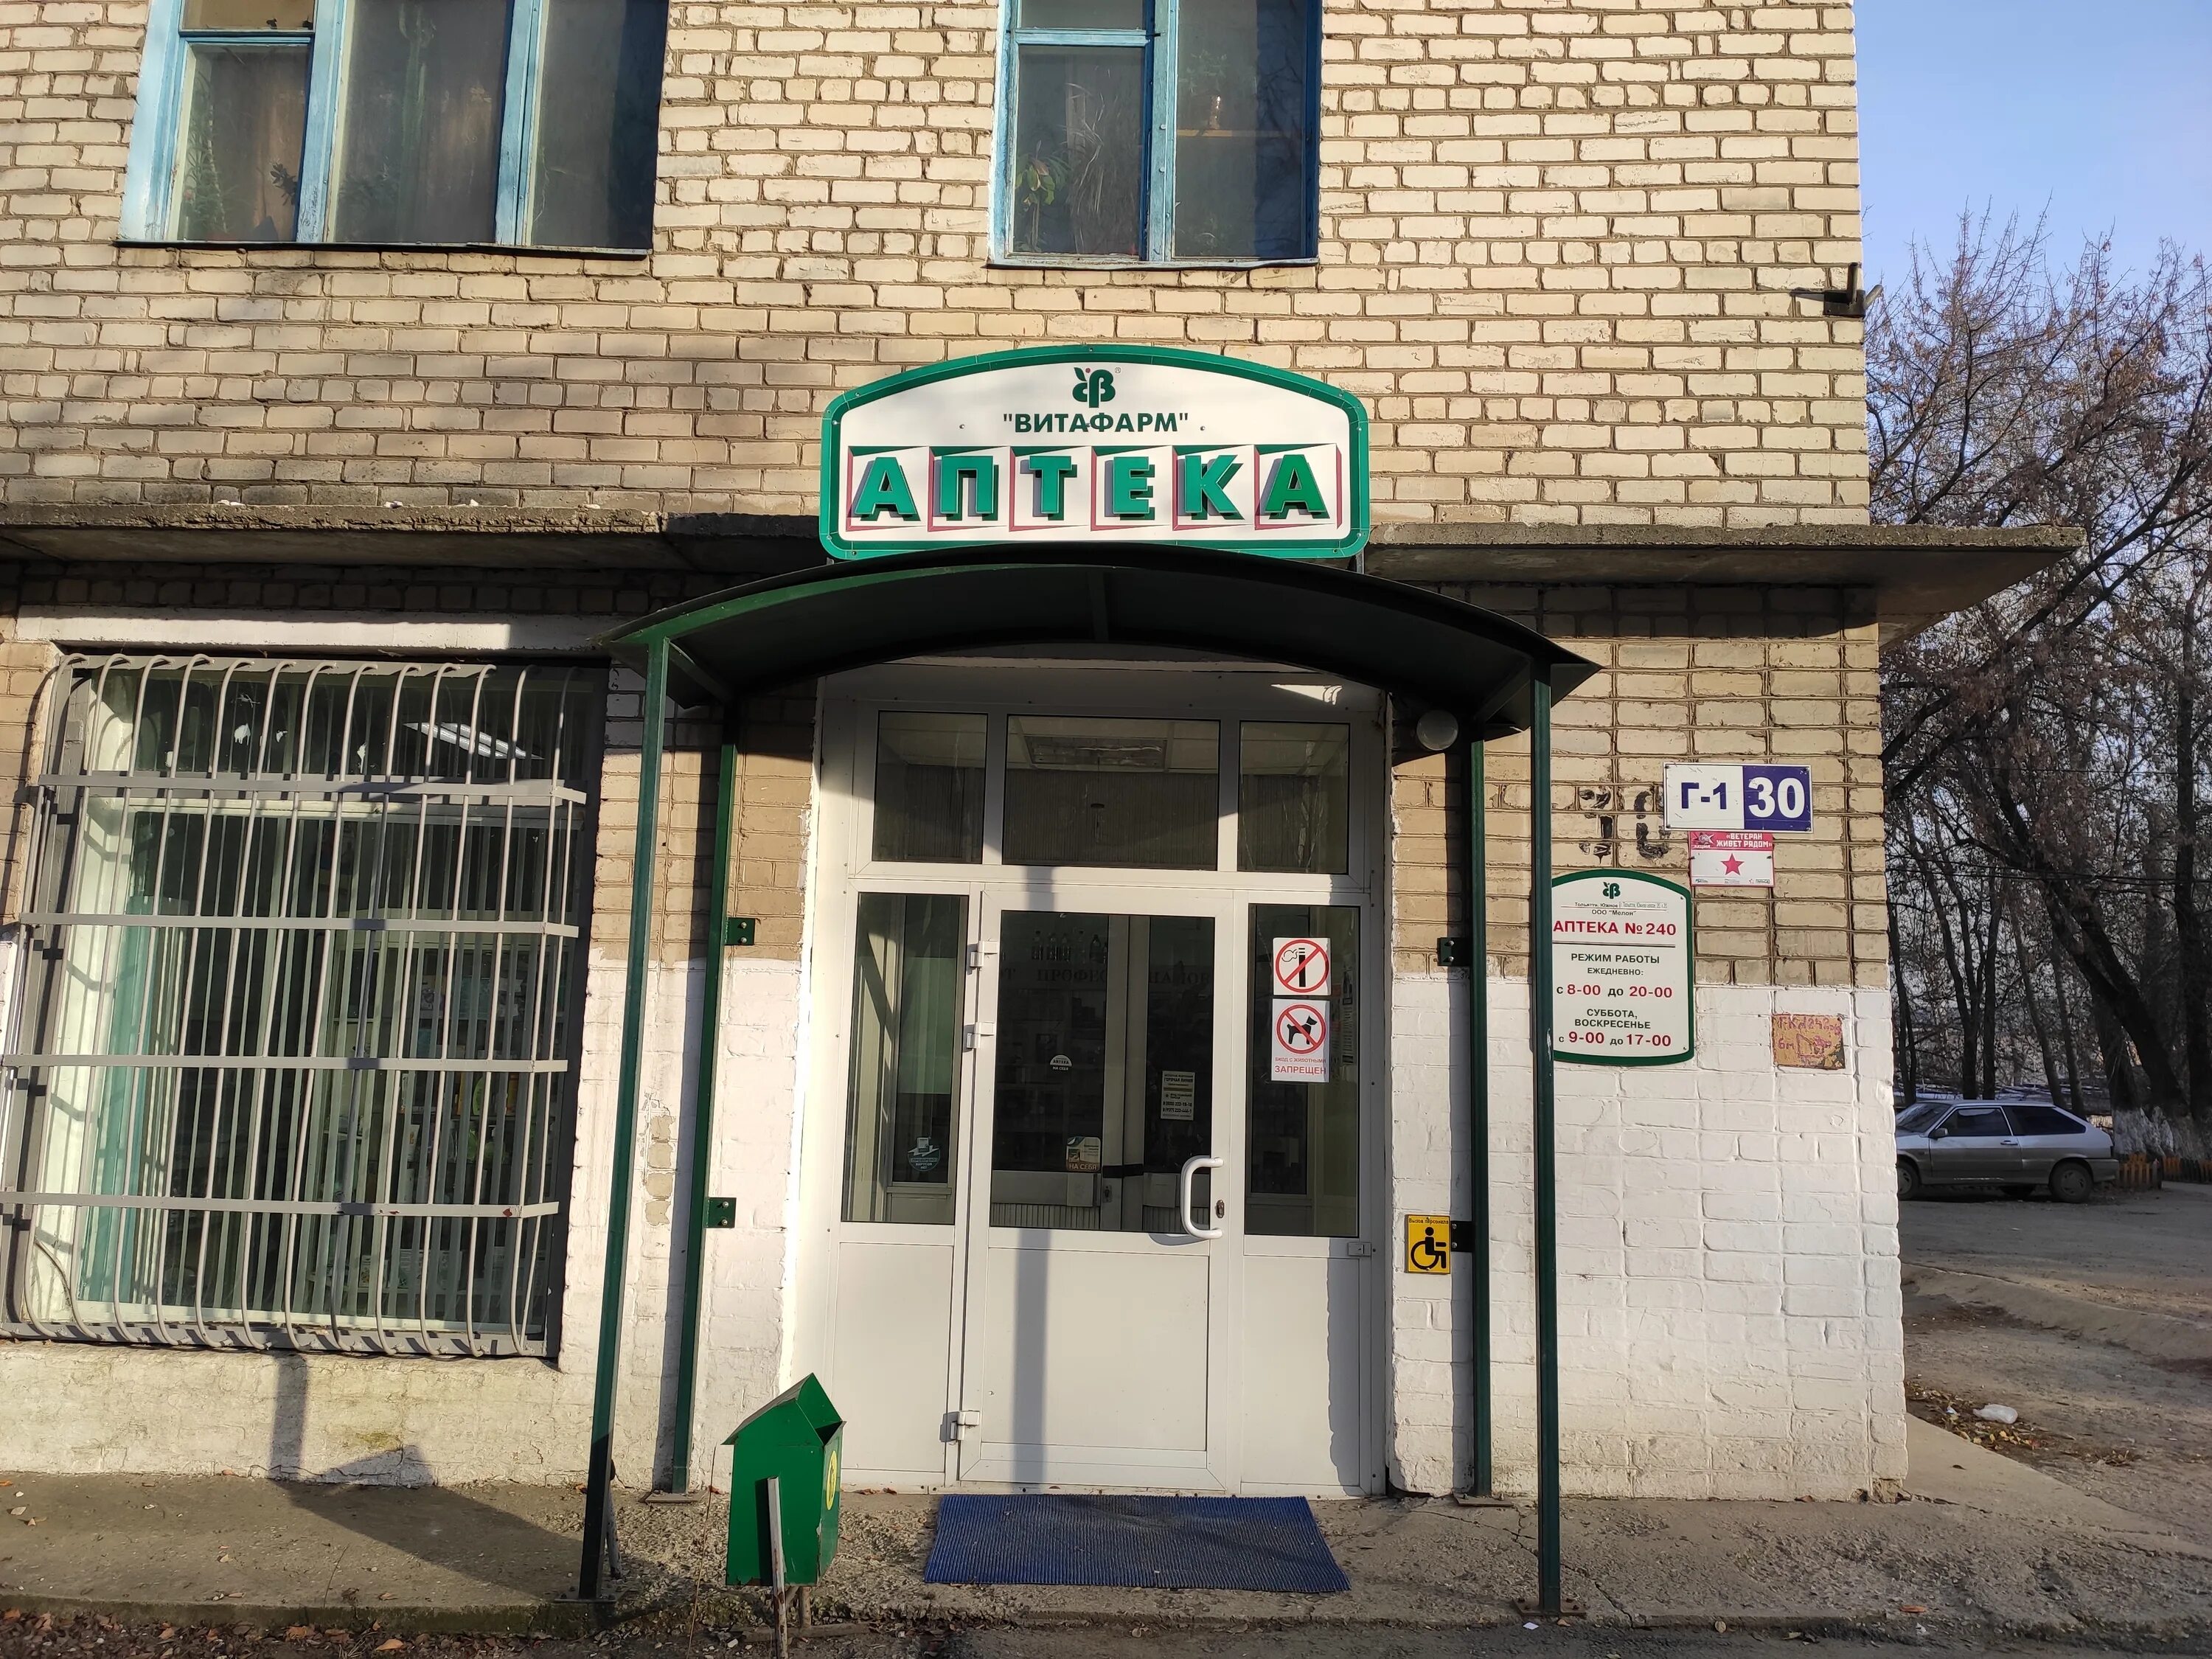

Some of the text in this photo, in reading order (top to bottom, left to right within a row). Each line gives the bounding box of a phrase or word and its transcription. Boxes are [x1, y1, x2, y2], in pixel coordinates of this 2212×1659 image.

[1003, 413, 1188, 434] "ВИТАФАРМ"
[852, 453, 1330, 521] АПТЕКА
[1681, 776, 1805, 818] Г-1 30
[1553, 920, 1619, 934] АПТЕКА
[1645, 922, 1677, 936] 240
[1571, 953, 1660, 964] РЕЖИМ РАБОТЫ
[1587, 967, 1644, 976] ЕЖЕДНЕВНО:
[1567, 984, 1601, 996] 8-00
[1607, 988, 1624, 998] до
[1629, 986, 1673, 998] 20-00
[1586, 1008, 1638, 1019] СУББОТА,
[1574, 1018, 1652, 1029] ВОСКРЕСЕНЬЕ
[1568, 1031, 1605, 1044] 9-00
[1610, 1037, 1624, 1046] до
[1626, 1034, 1672, 1047] 17-00
[1274, 1065, 1326, 1075] ЗАПРЕЩЕН
